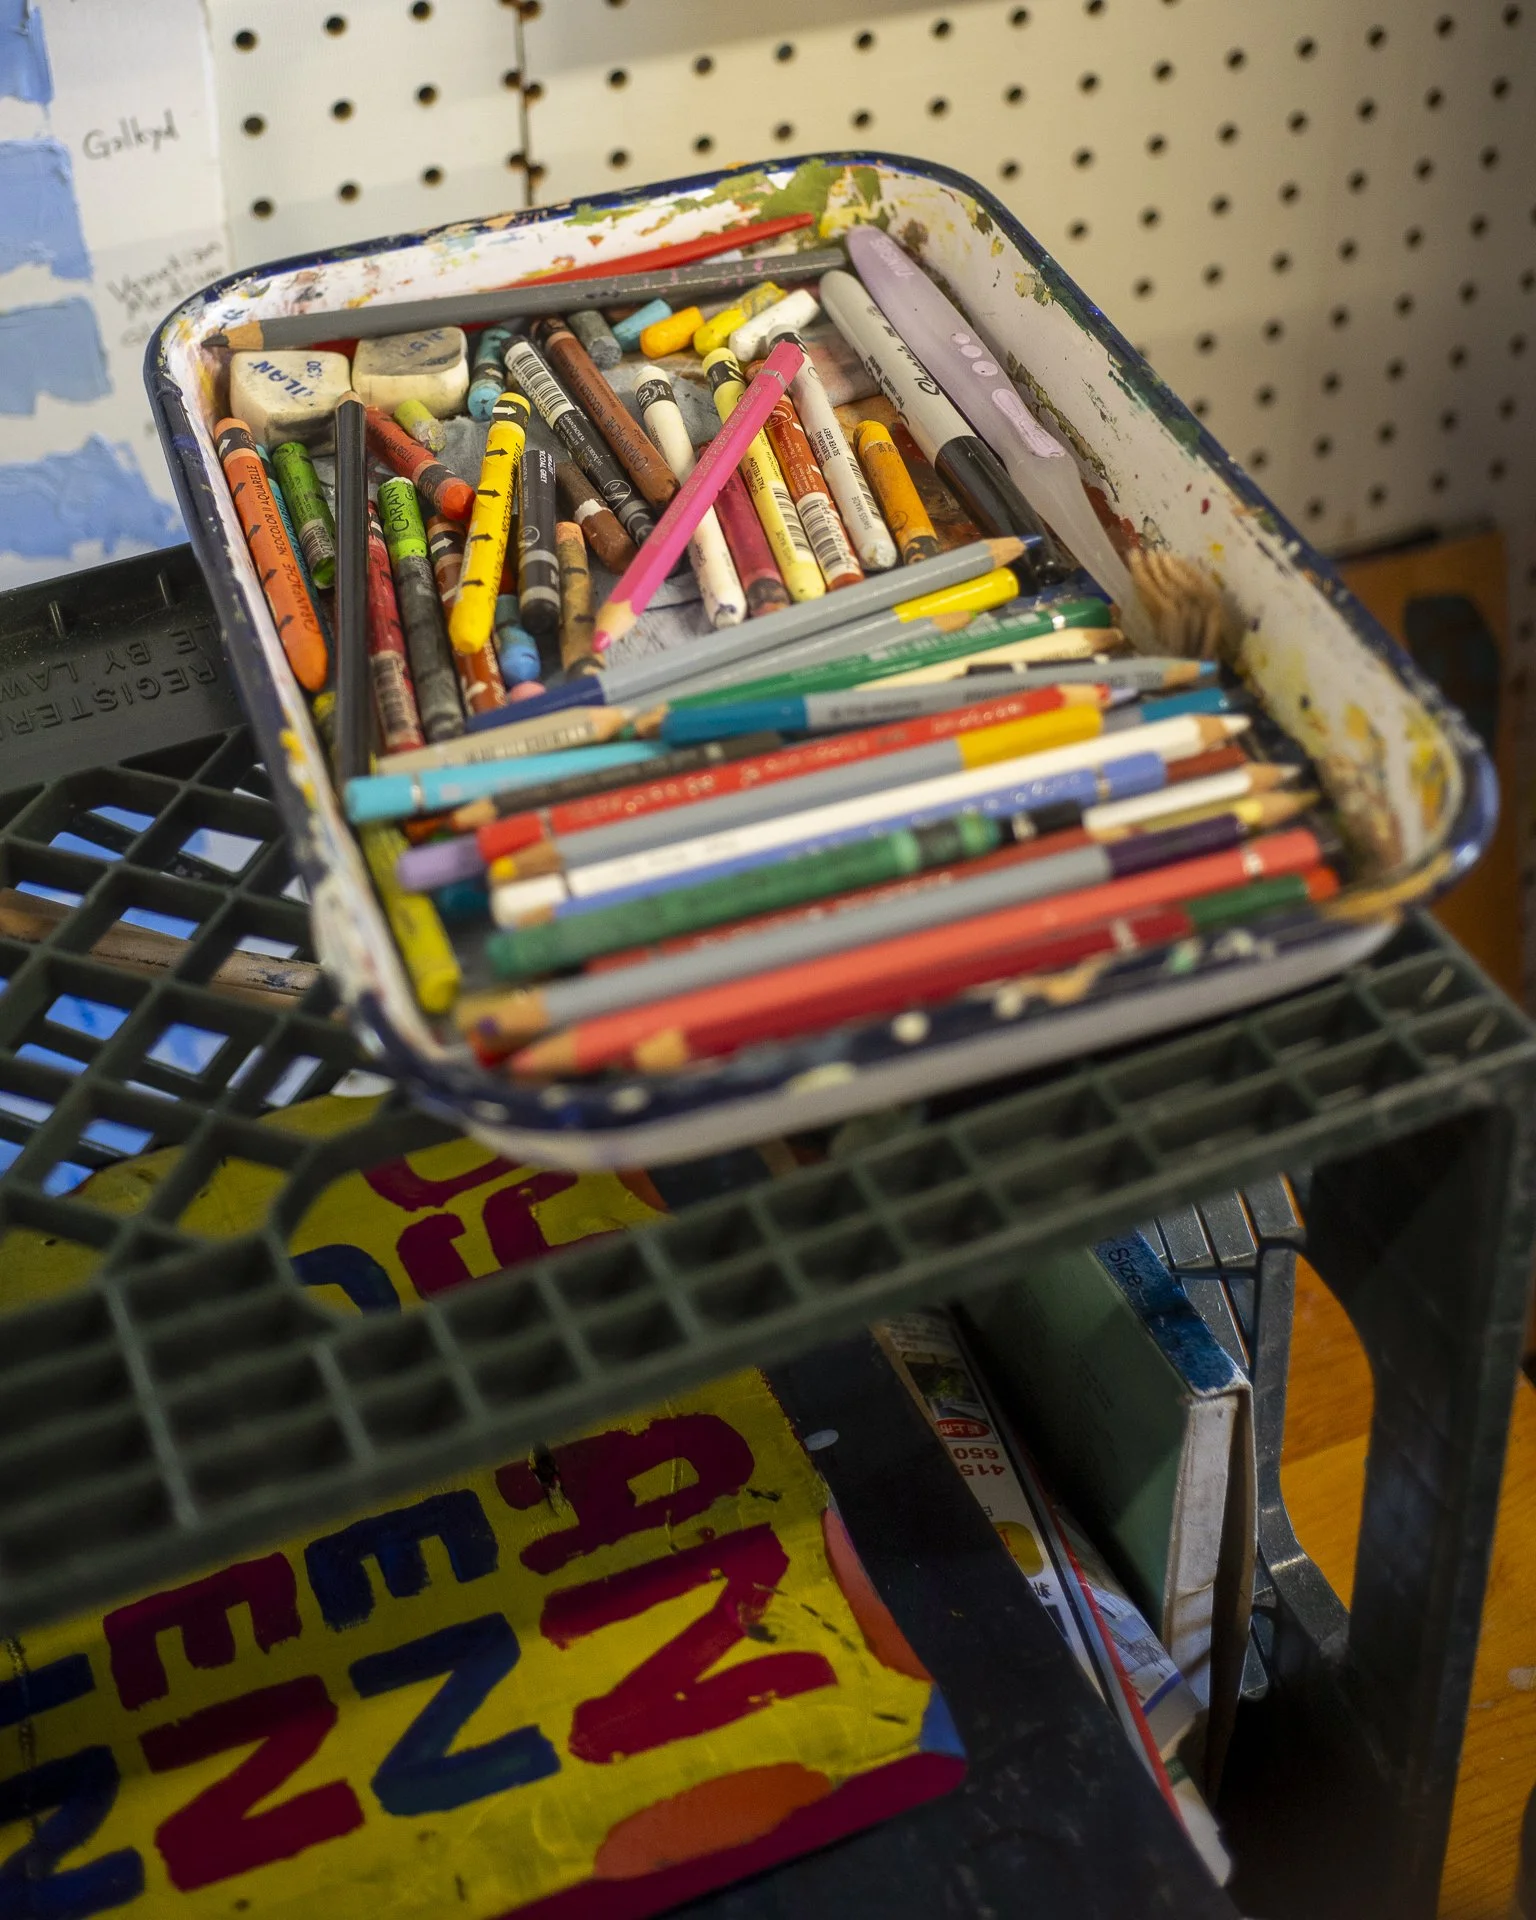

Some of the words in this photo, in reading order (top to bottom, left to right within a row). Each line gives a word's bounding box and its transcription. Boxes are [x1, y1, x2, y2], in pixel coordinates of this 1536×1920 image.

[254, 360, 314, 398] ILAN
[827, 439, 841, 457] SILVER
[747, 455, 762, 479] YELLOW
[246, 464, 271, 507] AQUARELLE
[755, 477, 765, 490] PALE
[850, 494, 865, 514] MADE
[858, 511, 873, 530] SWISS
[267, 513, 287, 557] NEOCOLOR
[105, 640, 150, 674] BY
[4, 657, 217, 736] REGISTER
[1108, 1248, 1142, 1287] Size
[954, 1447, 999, 1461] 650
[961, 1463, 1005, 1478] 415
